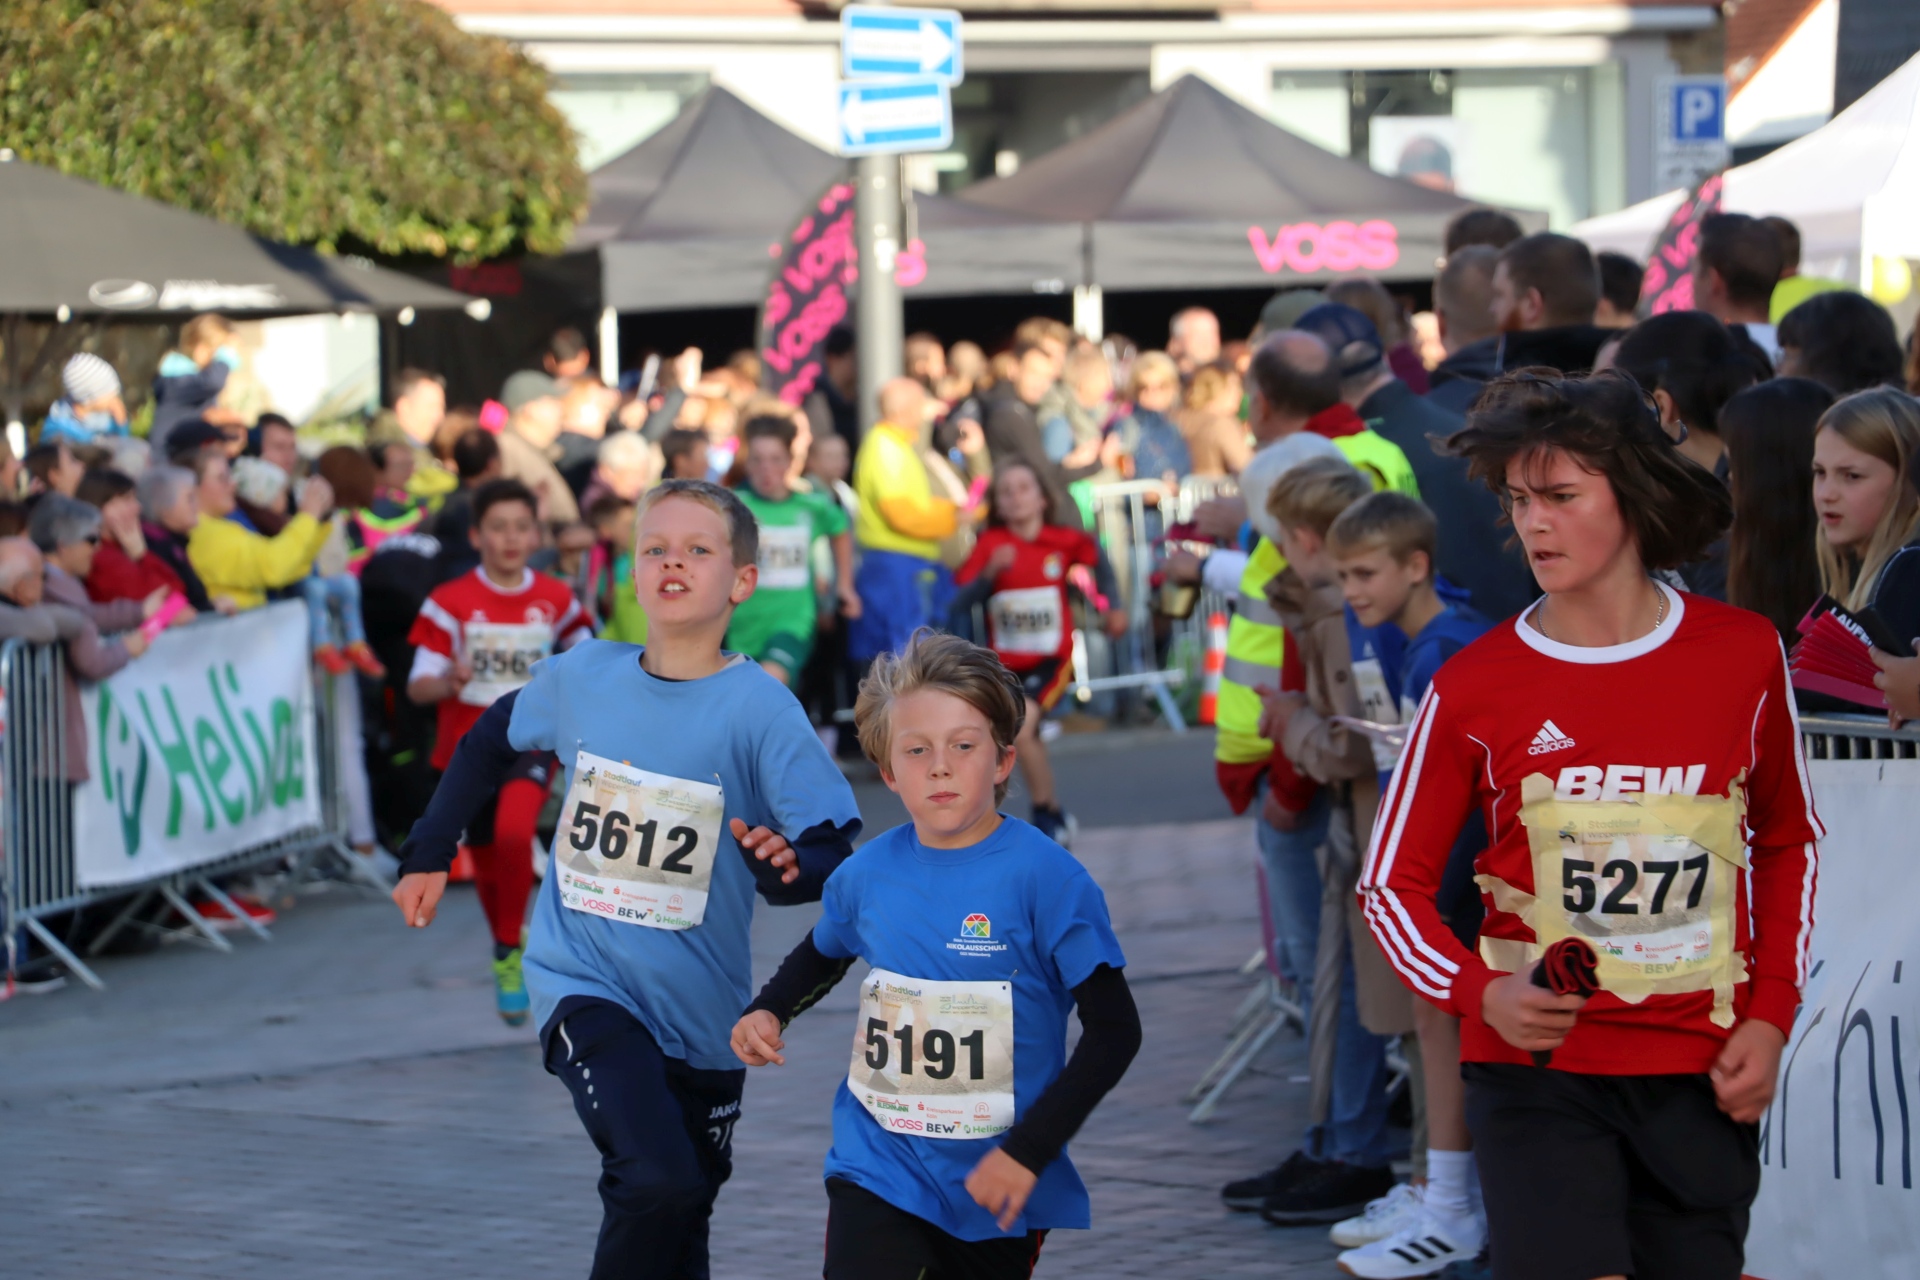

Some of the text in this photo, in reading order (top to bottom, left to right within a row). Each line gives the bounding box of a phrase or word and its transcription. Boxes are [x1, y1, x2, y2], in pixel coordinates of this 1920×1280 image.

[1681, 89, 1715, 137] P
[1247, 219, 1399, 273] VOSS
[762, 283, 848, 374] VOSS
[1527, 737, 1576, 755] adidas
[603, 770, 642, 787] Stadtlauf
[1554, 764, 1707, 802] BEW
[569, 801, 699, 875] 5612
[1562, 852, 1709, 915] 5277
[582, 897, 615, 914] VOSS
[617, 906, 648, 921] BEW
[662, 915, 692, 928] Helios
[946, 942, 1007, 951] NIKOLAUSSCHULE
[1644, 961, 1677, 975] BEW
[885, 983, 922, 997] Stadtlauf
[884, 992, 923, 1006] Wipperfürth
[865, 1017, 985, 1080] 5191
[926, 1106, 964, 1115] Kreissparkasse
[889, 1117, 923, 1131] VOSS
[926, 1123, 955, 1134] BEW
[972, 1124, 1004, 1134] Helios
